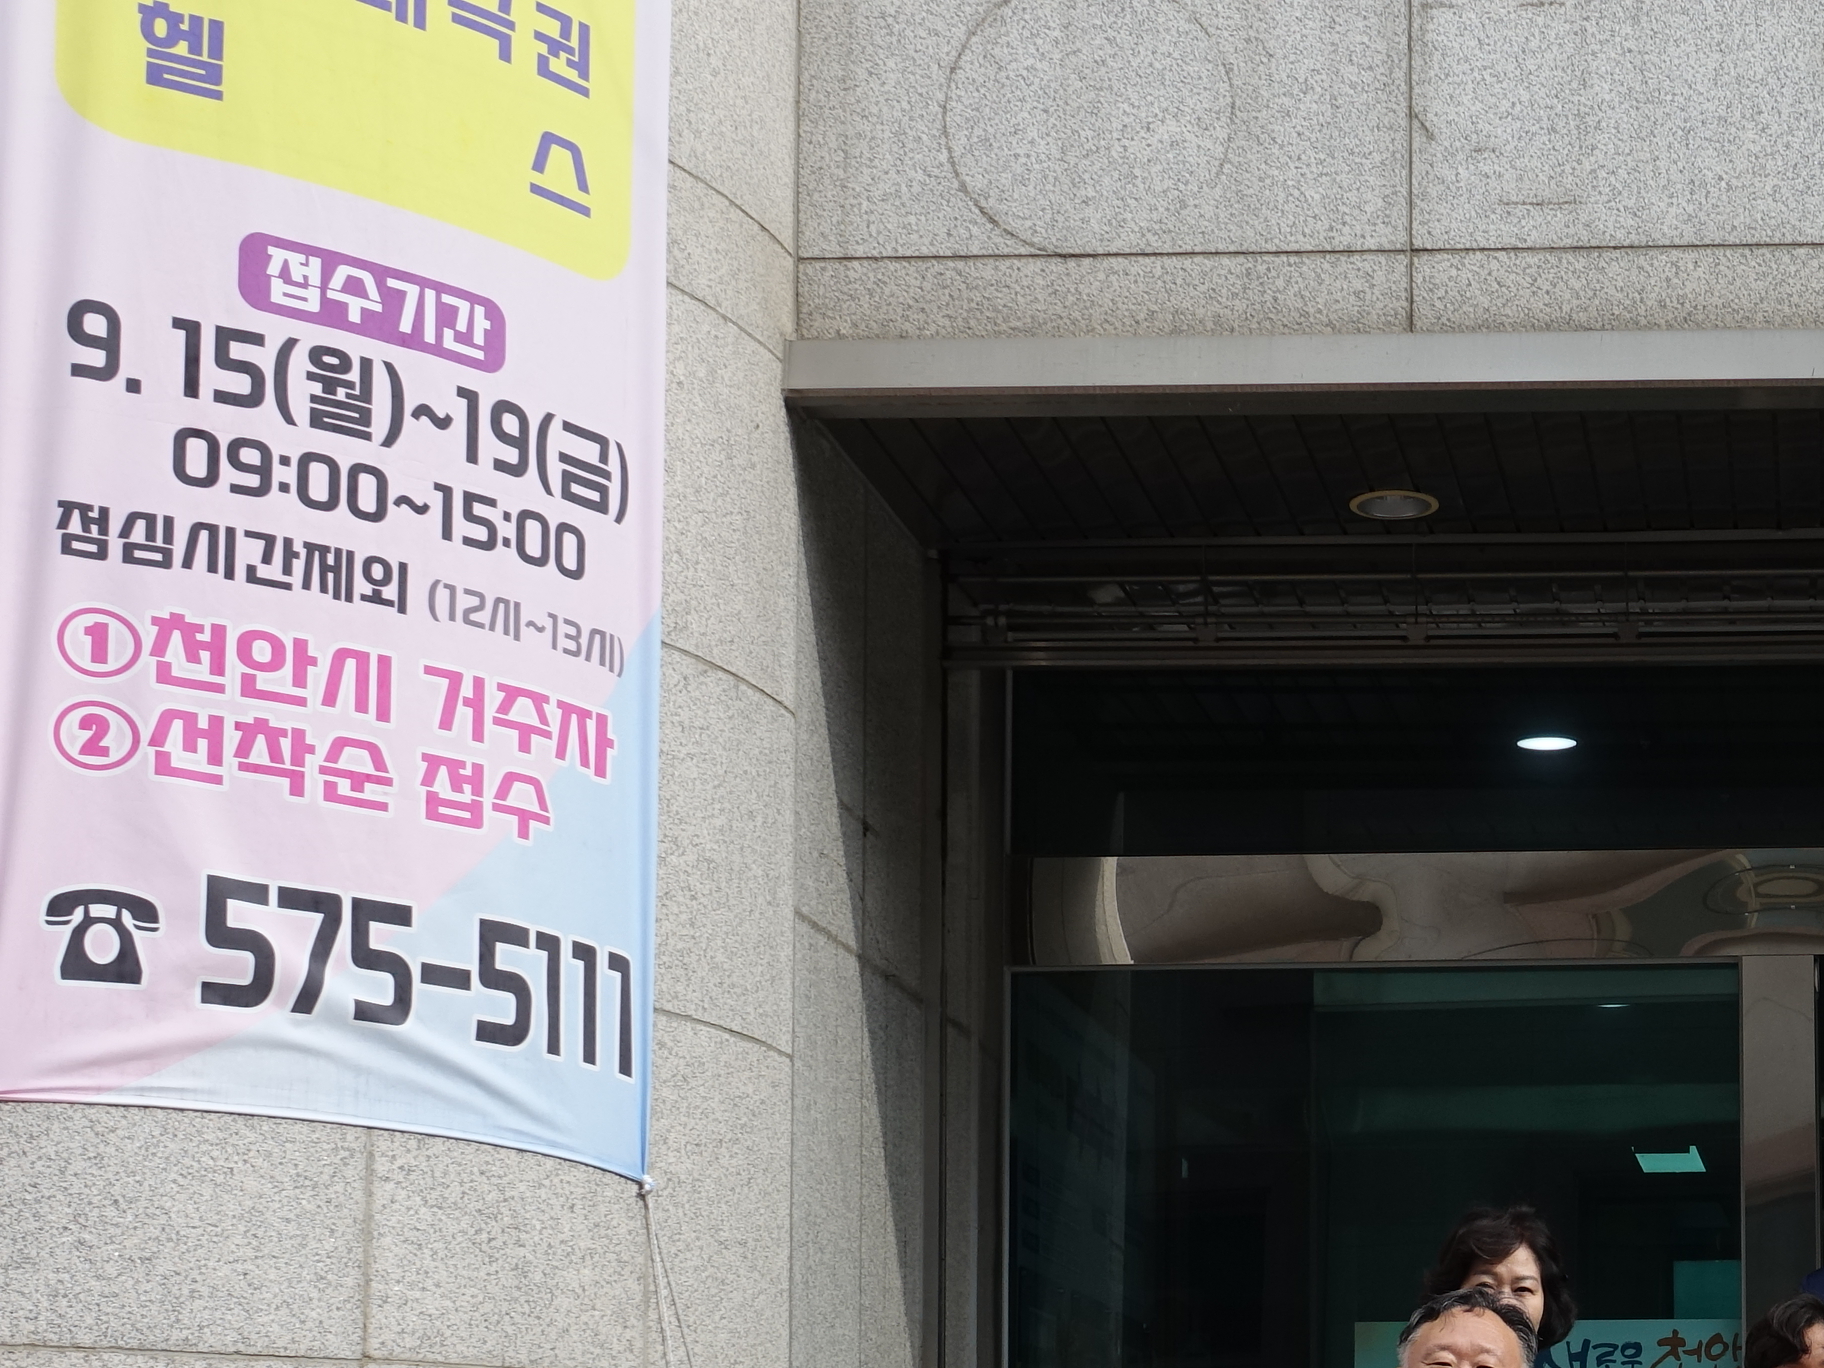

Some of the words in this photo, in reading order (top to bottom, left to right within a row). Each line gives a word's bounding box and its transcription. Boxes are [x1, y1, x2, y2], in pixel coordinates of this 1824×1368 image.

[66, 298, 143, 395] 9.
[265, 245, 491, 362] 접수기간
[172, 427, 587, 581] 09:00~15:00
[56, 499, 409, 616] 점심시간제외
[427, 578, 625, 679] (12시~13시)
[422, 664, 617, 779] 거주자
[419, 752, 551, 842] 접수
[199, 874, 634, 1078] 575-5111
